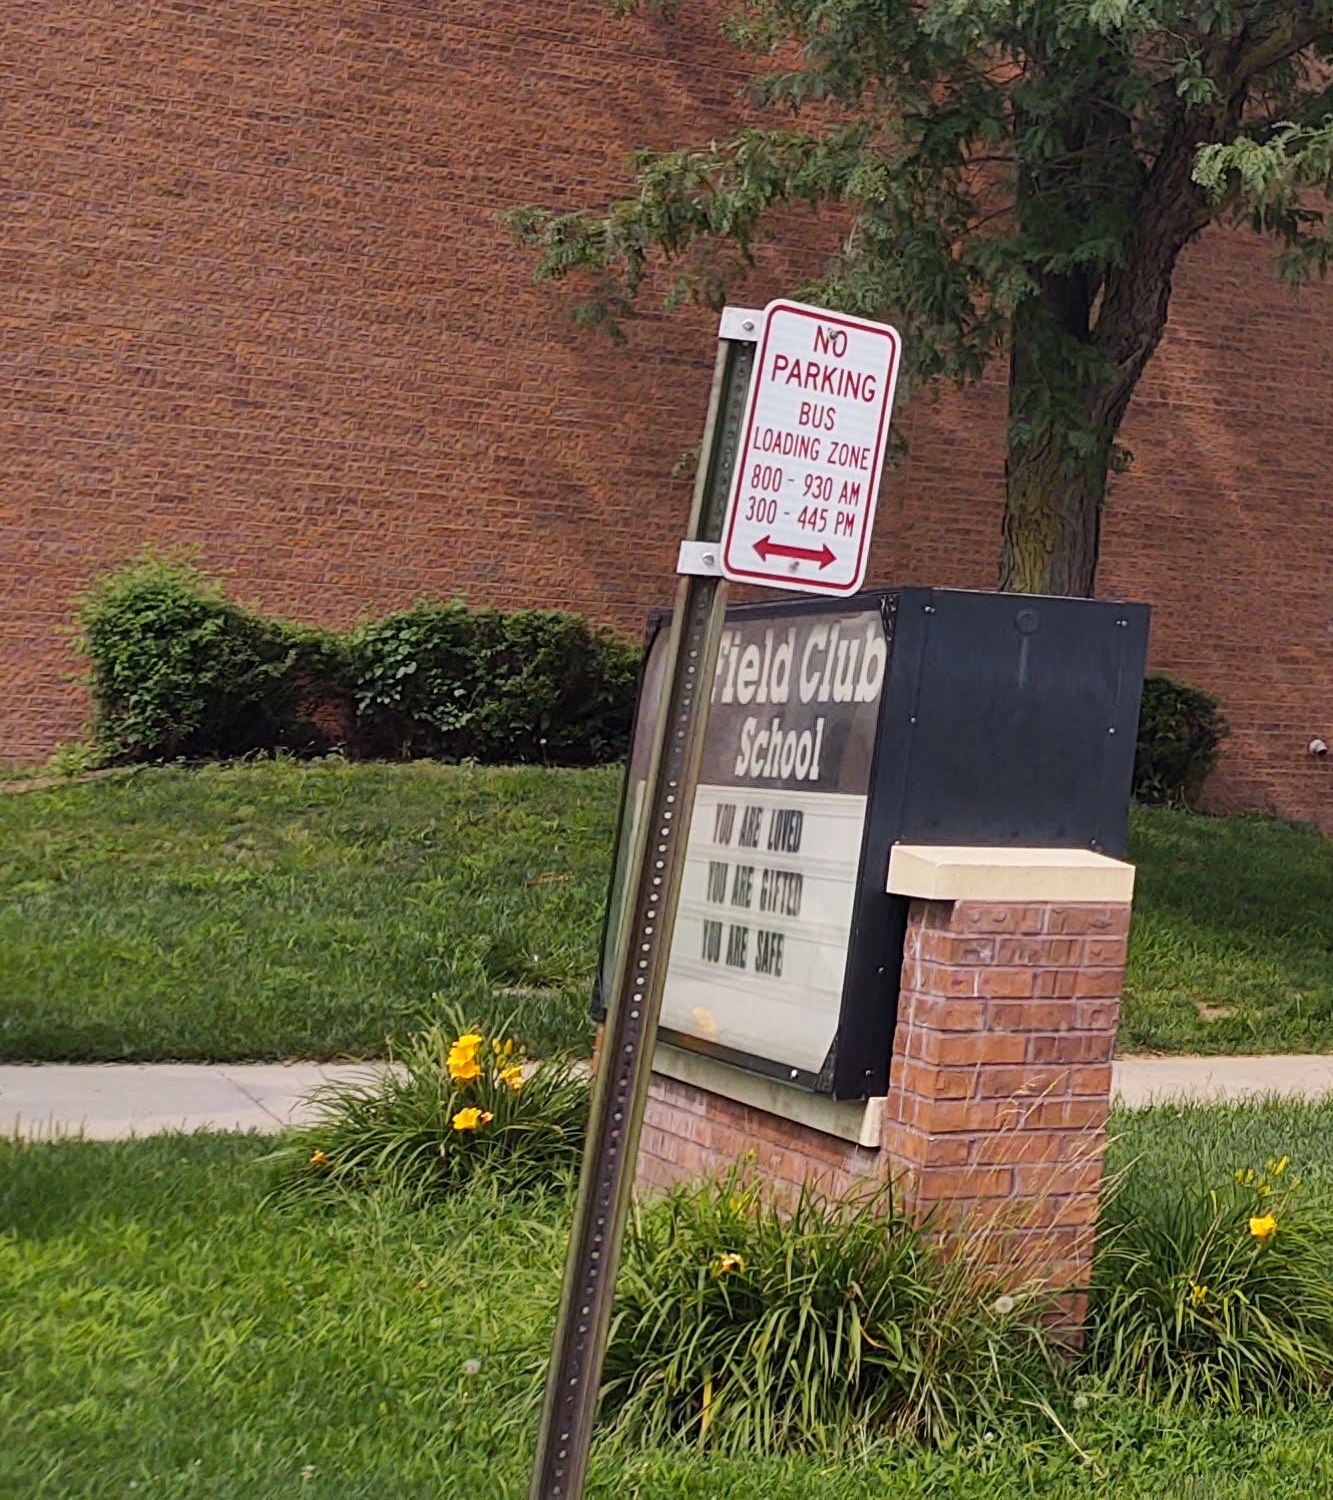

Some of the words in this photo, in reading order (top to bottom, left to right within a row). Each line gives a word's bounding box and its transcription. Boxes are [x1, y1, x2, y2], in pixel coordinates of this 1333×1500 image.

[813, 324, 848, 358] NO
[771, 354, 877, 403] PARKING
[798, 401, 836, 431] BUS
[752, 426, 821, 461] LOADING
[826, 441, 871, 470] ZONE
[751, 463, 783, 493] 800
[802, 473, 833, 502] 930
[837, 480, 861, 507] AM
[745, 495, 777, 525] 300
[797, 505, 828, 533] 445
[833, 510, 856, 538] PM
[799, 620, 888, 704] Club
[734, 716, 825, 782] School
[712, 803, 737, 846] YOU
[738, 805, 764, 849] ARE
[767, 808, 804, 853] LOVED
[706, 861, 729, 904] YOU
[730, 864, 755, 908] ARE
[759, 867, 804, 917] GIFTED
[701, 918, 723, 964] YOU
[725, 923, 749, 969] ARE
[755, 929, 785, 978] SAFE
